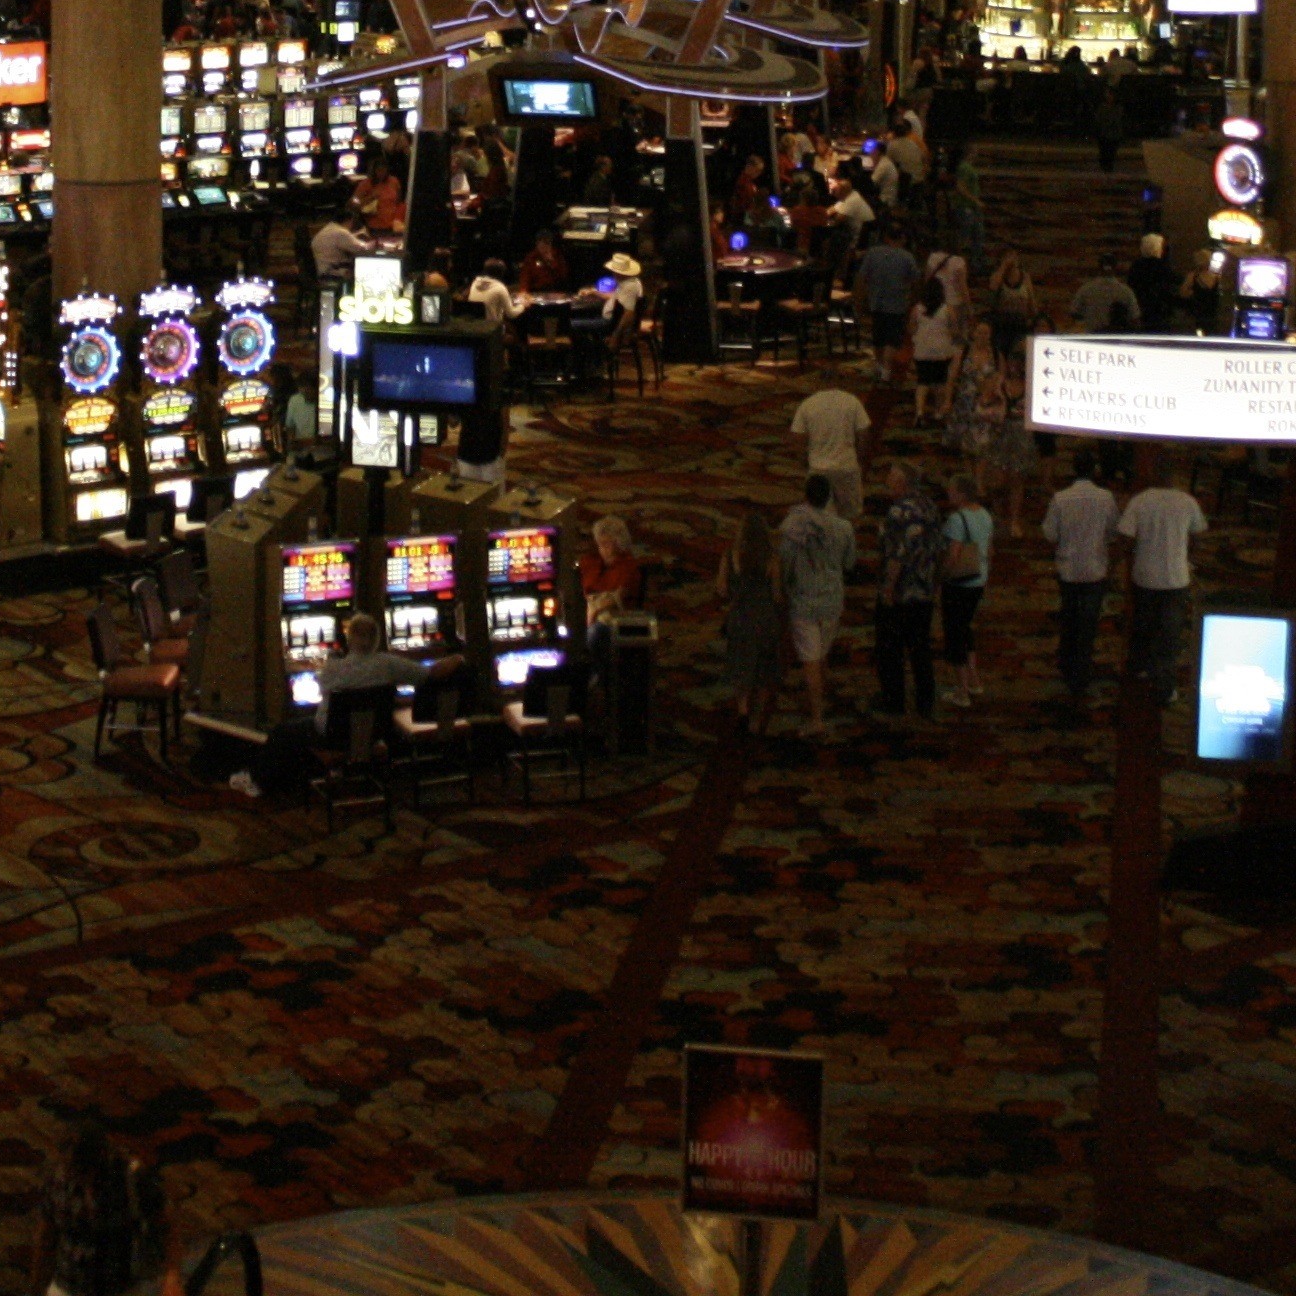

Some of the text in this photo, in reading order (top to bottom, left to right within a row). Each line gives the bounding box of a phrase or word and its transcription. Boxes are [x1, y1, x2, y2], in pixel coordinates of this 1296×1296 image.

[339, 282, 414, 325] slots
[1059, 347, 1137, 368] SELF PARK
[1223, 358, 1283, 374] ROLLER
[1059, 368, 1104, 384] VALET
[1203, 378, 1284, 394] ZUMANITY
[1058, 387, 1177, 410] PLAYERS CLUB
[1058, 406, 1147, 427] RESTROOMS
